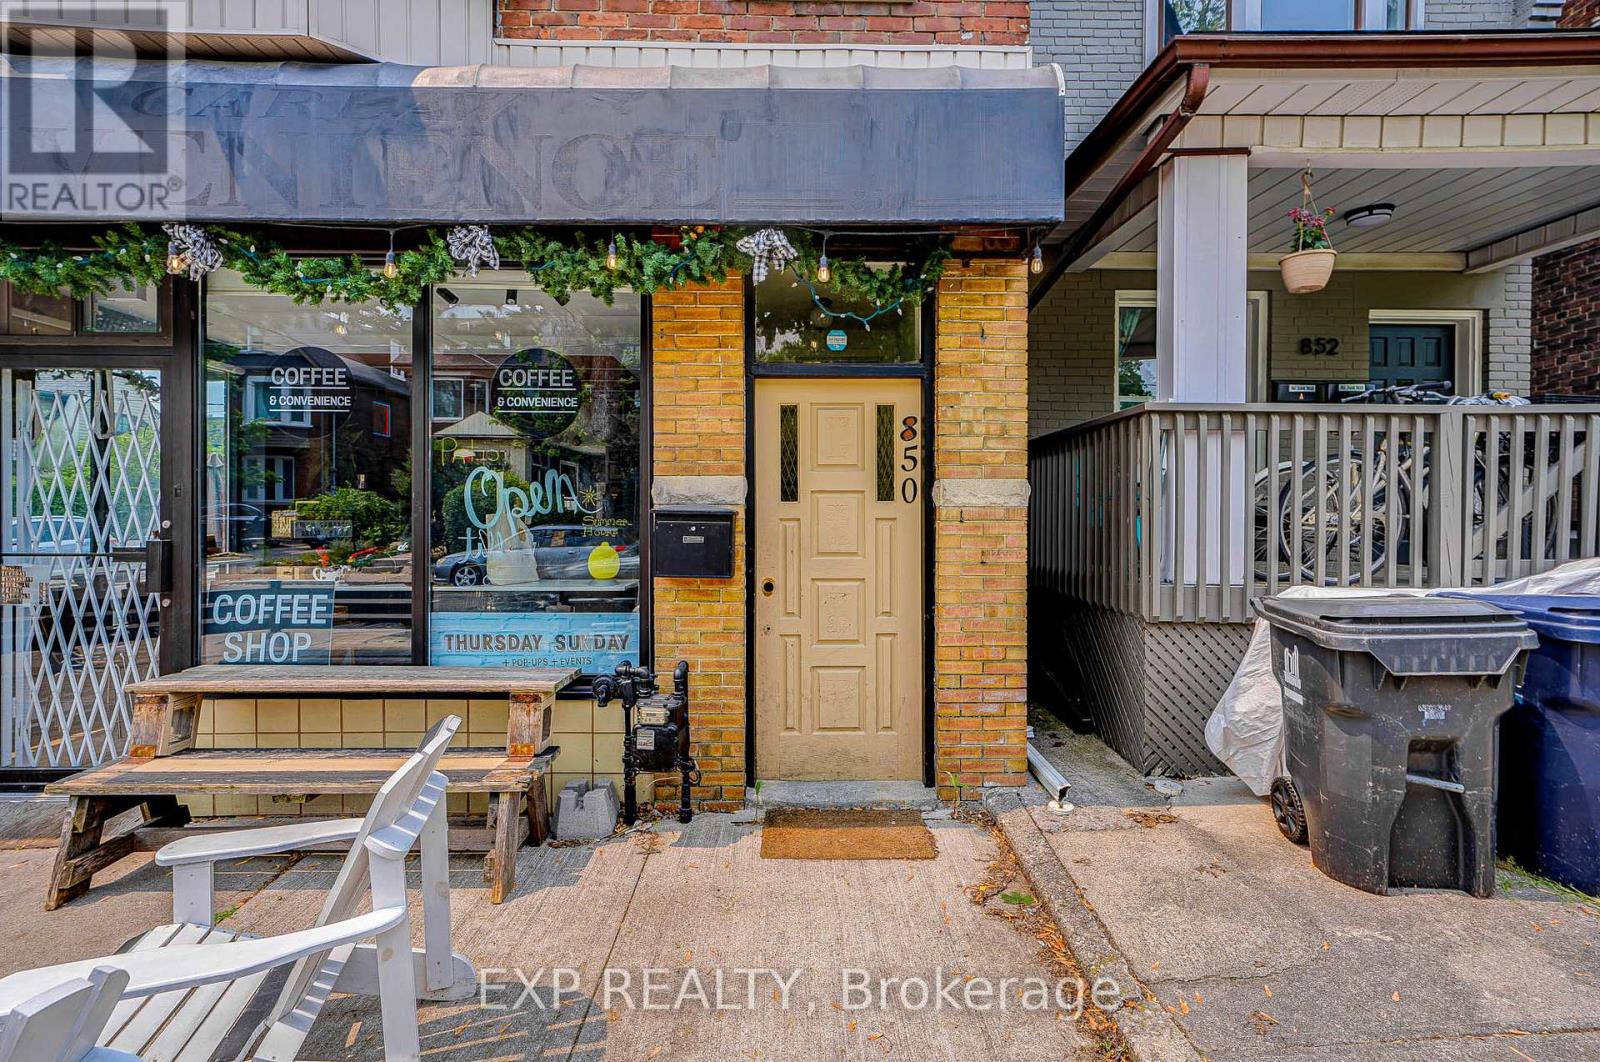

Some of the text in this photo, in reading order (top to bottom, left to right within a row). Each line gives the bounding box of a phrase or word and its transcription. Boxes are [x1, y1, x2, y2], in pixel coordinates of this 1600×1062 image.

[1299, 337, 1340, 356] 852
[271, 367, 347, 386] COFFEE
[499, 368, 573, 388] COFFEE
[278, 395, 352, 407] CONVENIENCE
[506, 397, 578, 408] CONVENIENCE
[900, 415, 918, 504] 850
[464, 466, 603, 535] Open
[213, 594, 328, 625] COFFEE
[223, 632, 312, 664] SHOP
[443, 633, 544, 652] THURSDAY
[512, 657, 549, 667] POP-UPS
[560, 656, 593, 666] EVENTS
